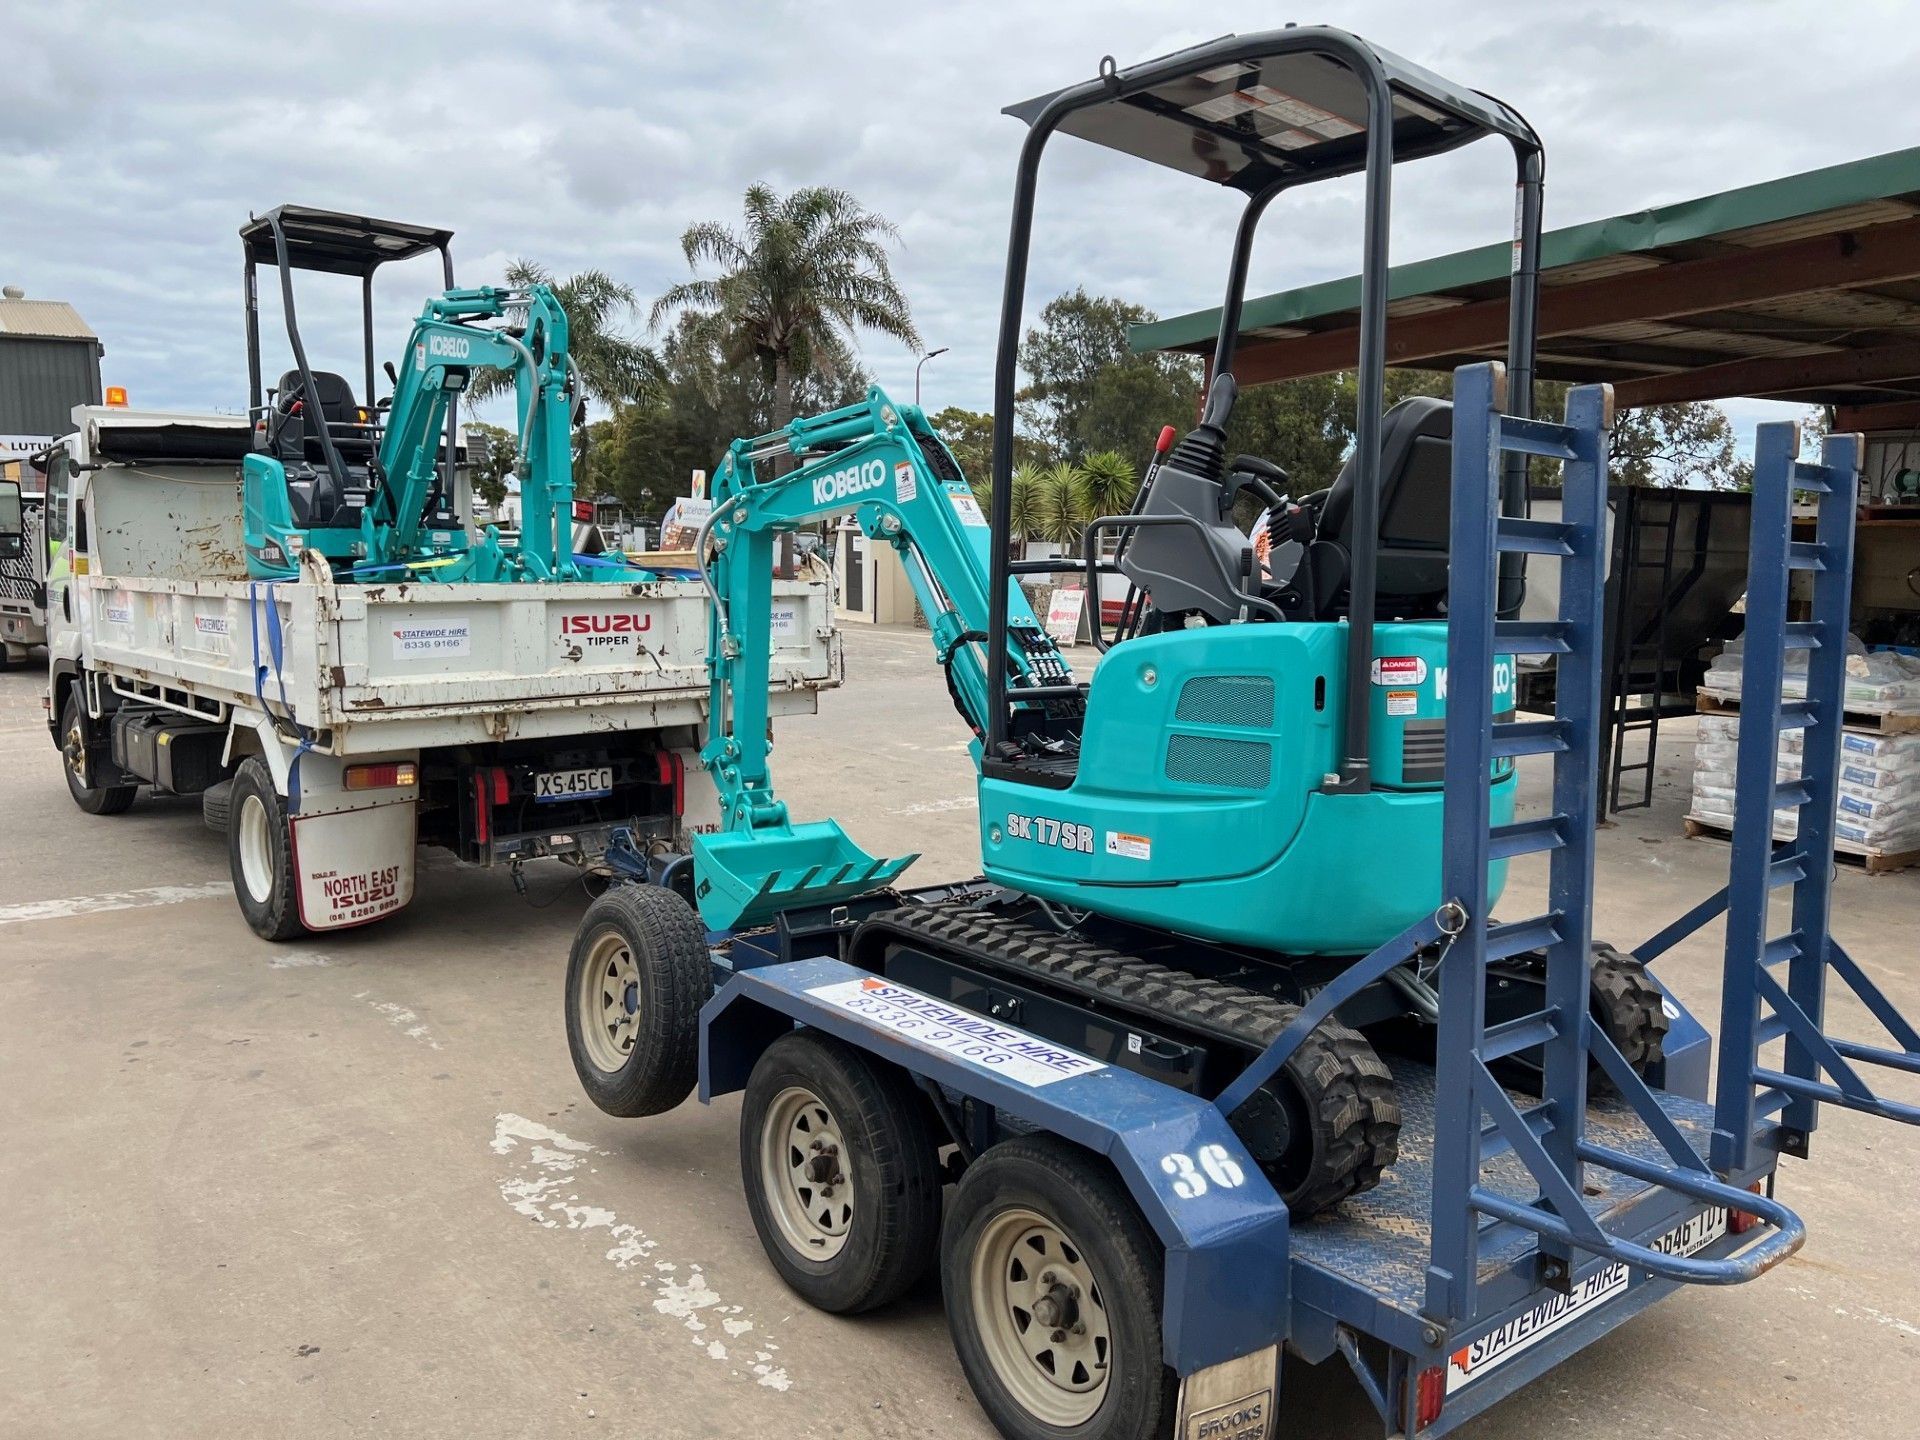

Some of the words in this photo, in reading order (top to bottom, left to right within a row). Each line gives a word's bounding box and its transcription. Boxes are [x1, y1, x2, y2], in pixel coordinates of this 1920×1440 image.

[430, 335, 470, 359] KOBELCO
[11, 442, 52, 451] LUTU
[812, 459, 886, 506] KOBELCO
[200, 618, 225, 631] STATEWIDE
[562, 614, 652, 634] ISUZU
[780, 612, 794, 620] HIRE
[402, 629, 447, 638] STATEWIDE
[448, 628, 467, 636] HIRE
[404, 641, 432, 649] 8336
[433, 639, 460, 648] 9166
[586, 636, 629, 646] TIPPER
[323, 873, 368, 898] NORTH
[371, 865, 400, 889] EAST
[332, 884, 396, 909] ISUZU
[328, 912, 346, 922] (08)
[845, 998, 925, 1029] 8336
[924, 1030, 1013, 1065] 9166
[872, 986, 1018, 1043] STATEWIDE
[1007, 1039, 1092, 1070] HIRE
[1161, 1144, 1245, 1199] 36
[1685, 1233, 1713, 1254] AUSTRALIA
[1471, 1288, 1579, 1364] STATEWIDE
[1583, 1261, 1625, 1299] HIRE
[1197, 1403, 1262, 1439] BROOKS
